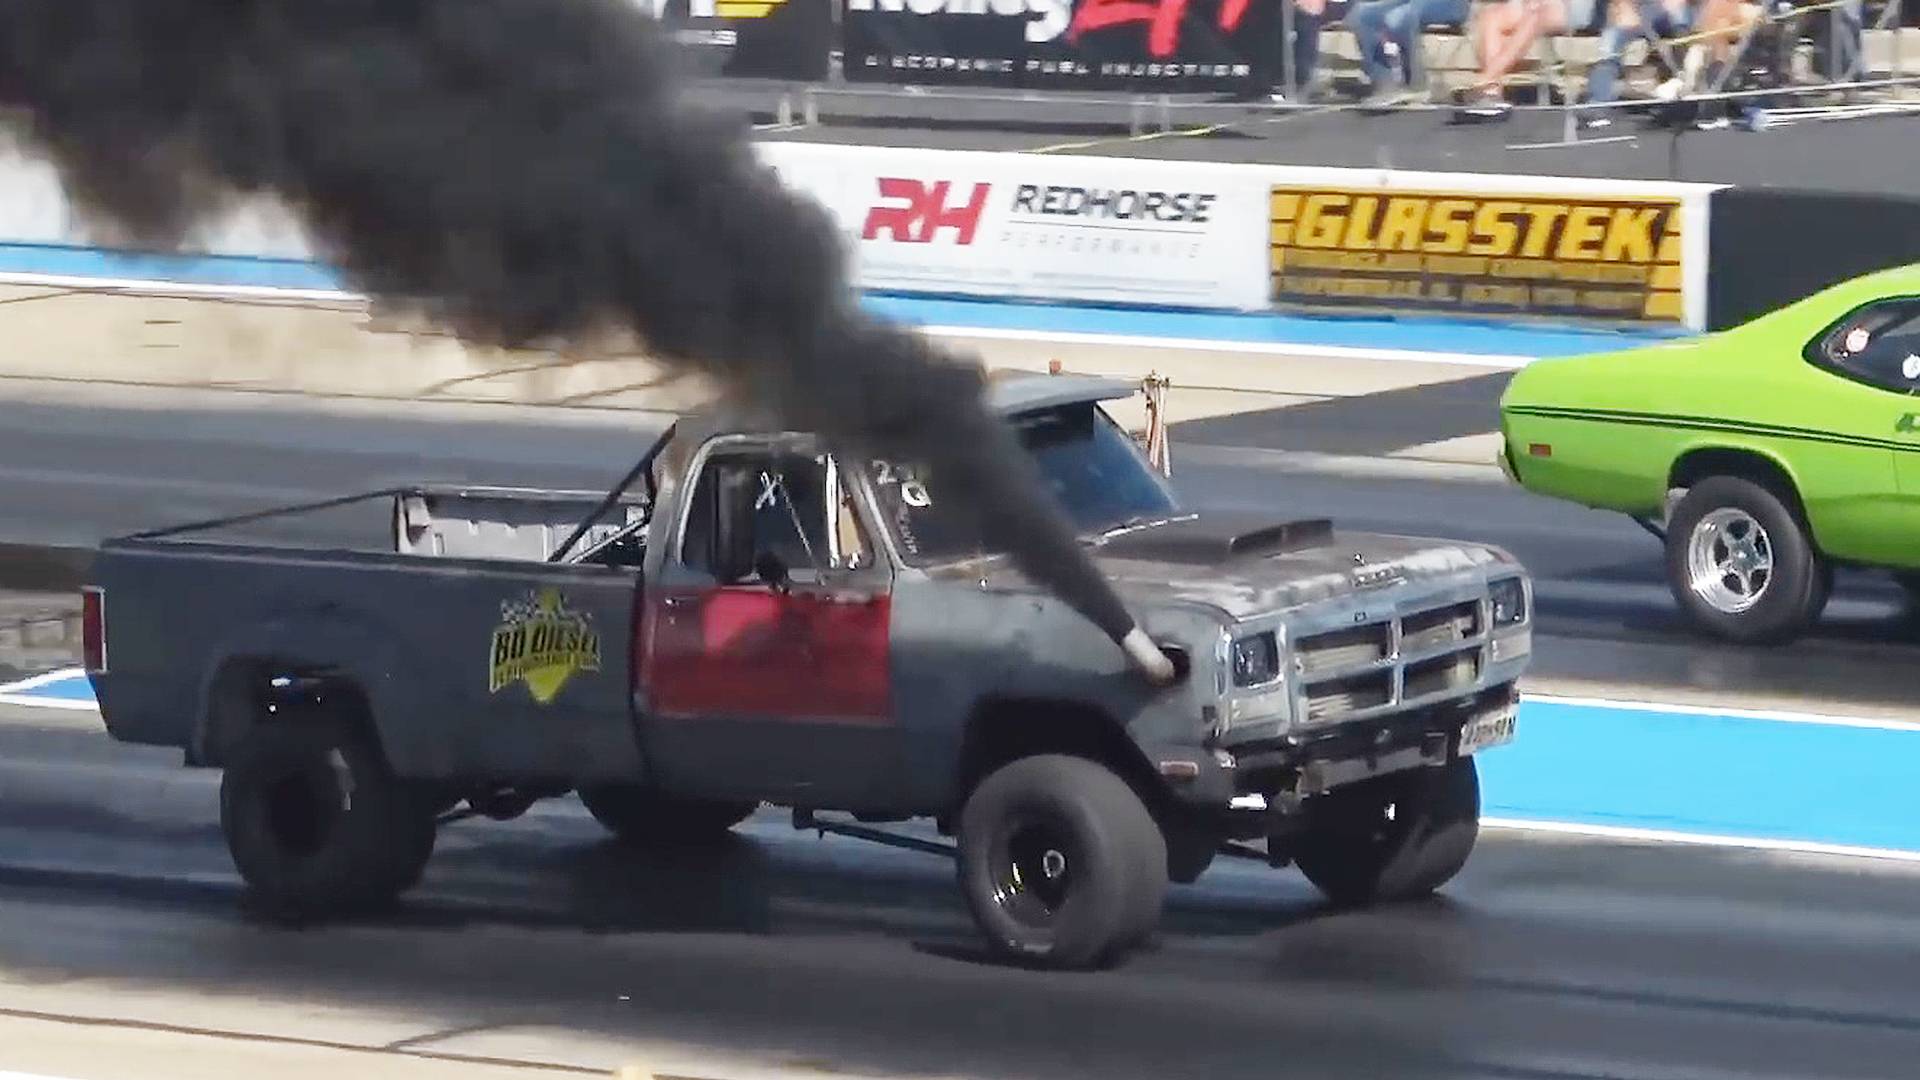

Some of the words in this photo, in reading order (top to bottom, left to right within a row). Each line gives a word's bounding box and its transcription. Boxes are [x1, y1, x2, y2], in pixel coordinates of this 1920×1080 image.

[862, 177, 993, 245] RH
[1011, 184, 1217, 223] REDHORSE
[1295, 193, 1661, 263] GLASSTEK
[531, 622, 600, 655] DIESEL
